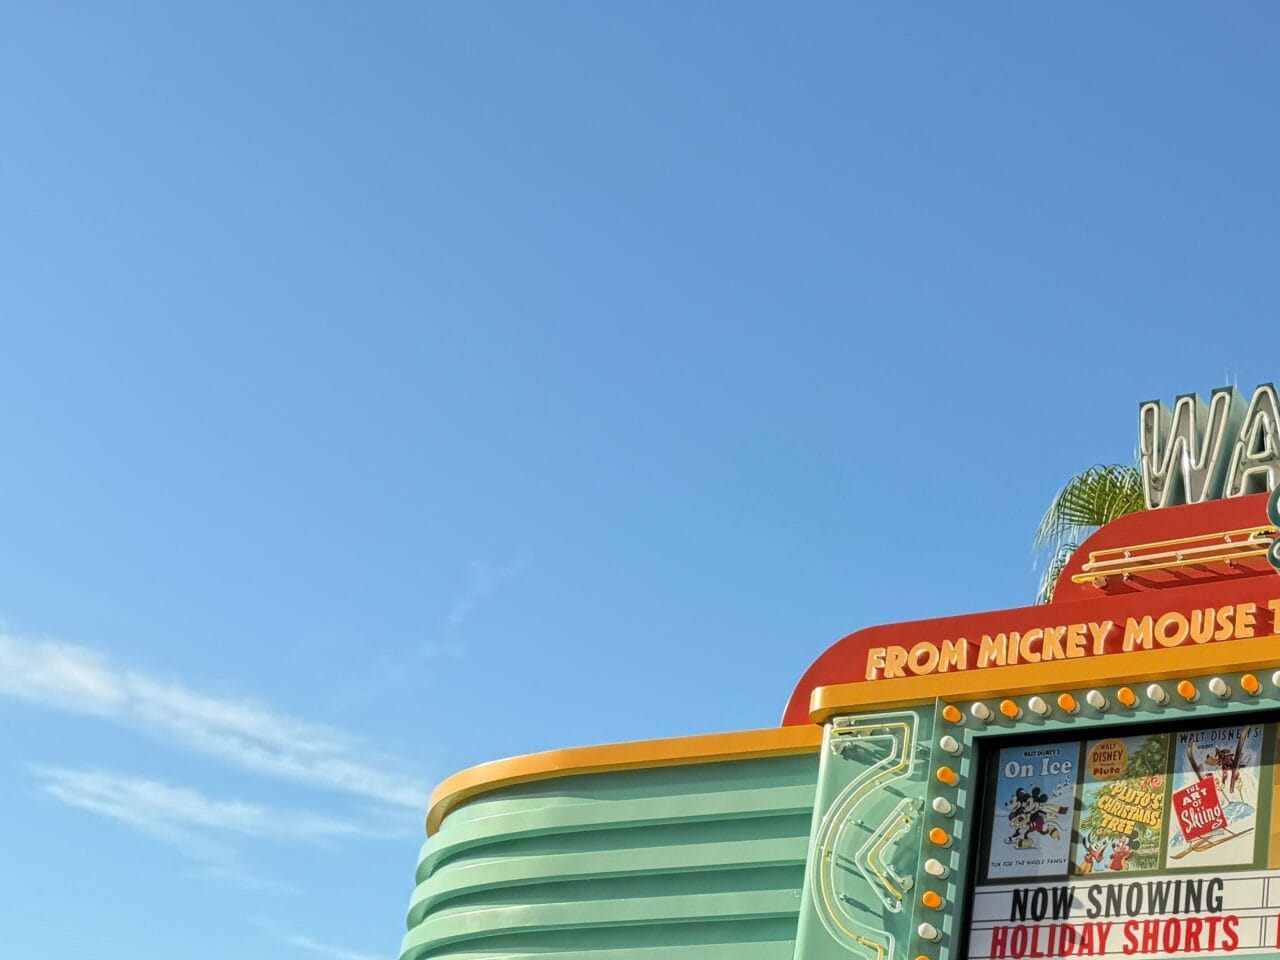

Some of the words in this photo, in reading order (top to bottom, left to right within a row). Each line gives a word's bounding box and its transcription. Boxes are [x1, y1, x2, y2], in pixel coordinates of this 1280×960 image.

[865, 637, 967, 681] FROM
[976, 621, 1115, 668] MICKEY
[1122, 602, 1256, 651] MOUSE
[1101, 743, 1116, 751] WALT
[1181, 732, 1204, 743] WALT
[1093, 750, 1123, 762] DISNEY
[1005, 761, 1034, 778] On
[1041, 758, 1072, 776] Ice
[1093, 767, 1120, 776] Pluto
[1109, 782, 1163, 810] PLUTO'S
[1182, 788, 1208, 806] ART
[1186, 784, 1200, 794] THE
[1098, 795, 1161, 829] CHRISTMAS
[1192, 799, 1201, 807] OF
[1101, 813, 1135, 835] TREE
[1181, 803, 1222, 833] Skiing
[1010, 885, 1077, 922] NOW
[1086, 877, 1224, 919] SNOWING
[990, 921, 1112, 960] HOLIDAY
[1123, 915, 1239, 955] SHORTS
